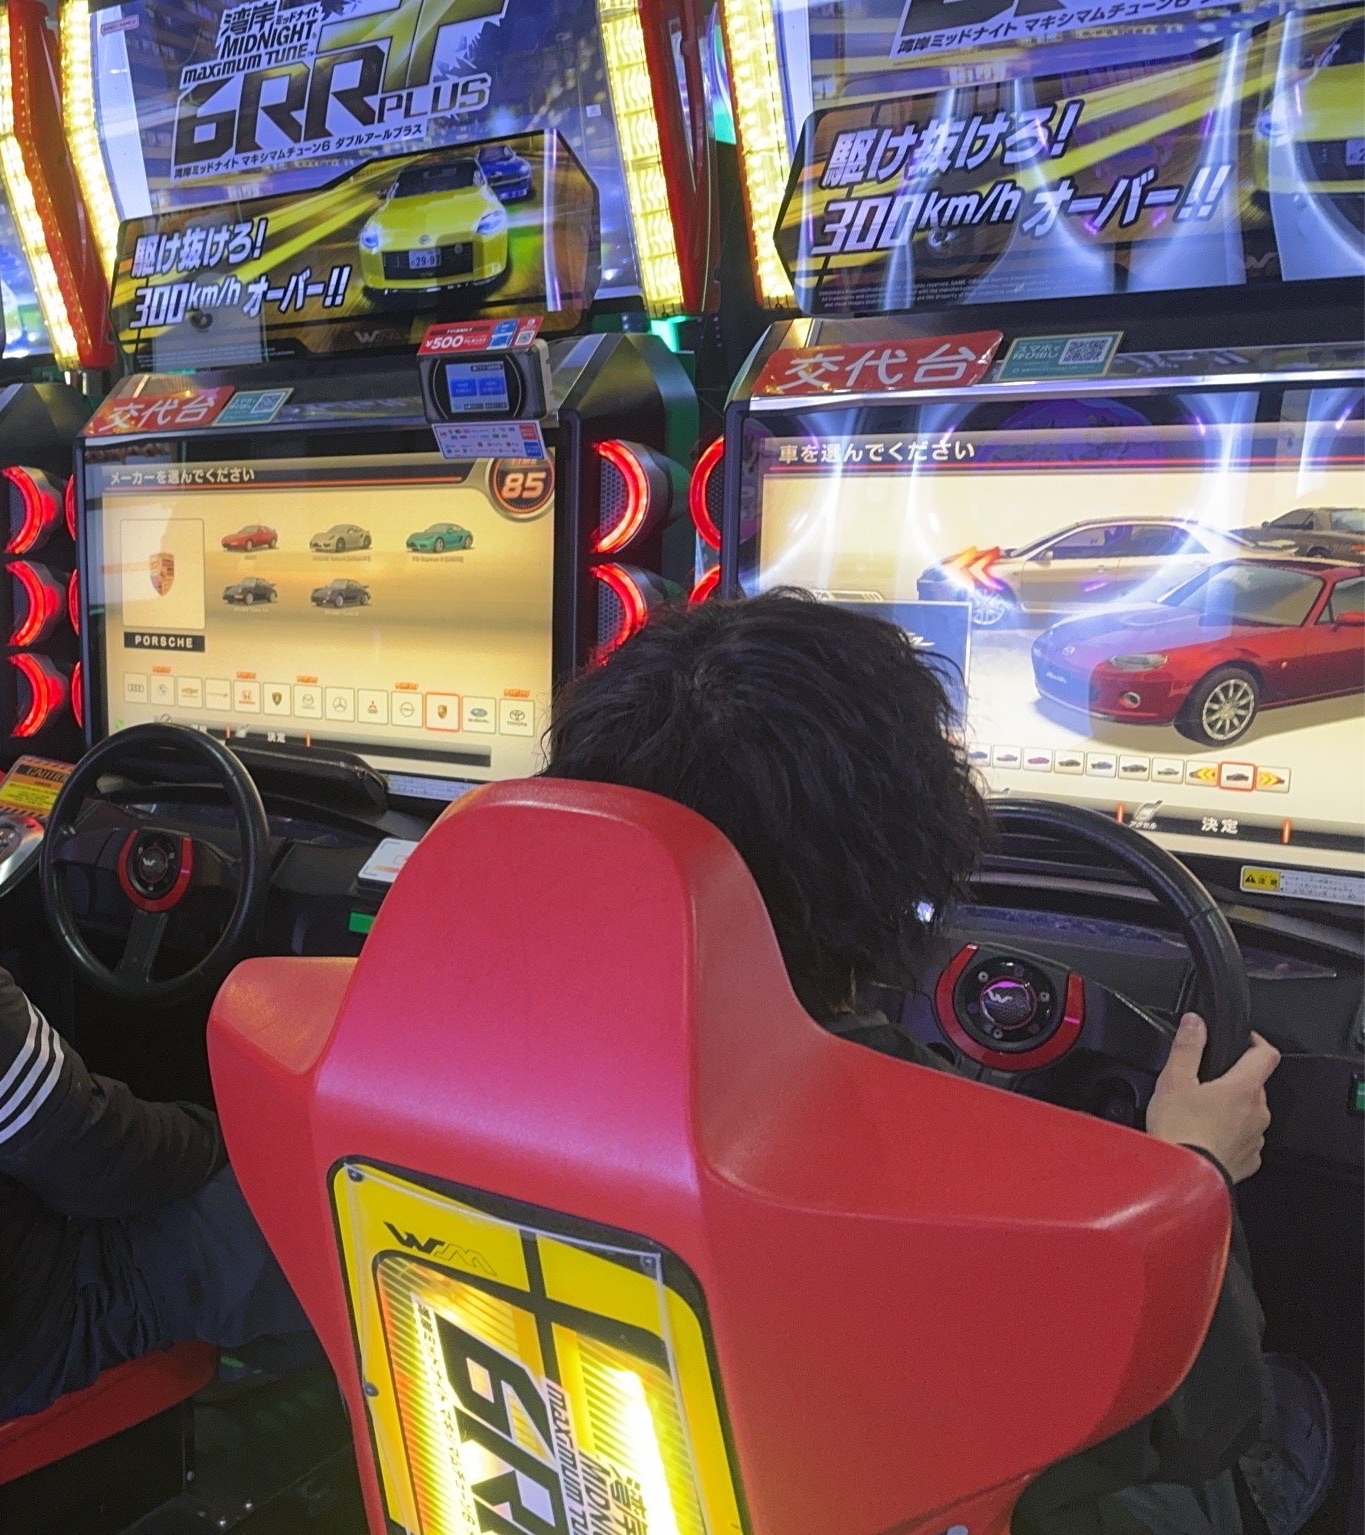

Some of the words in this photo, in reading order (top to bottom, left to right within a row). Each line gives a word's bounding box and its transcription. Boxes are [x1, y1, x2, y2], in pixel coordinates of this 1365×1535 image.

[221, 19, 315, 59] MIDNIGHT
[896, 23, 1018, 54] 湾岸ミッドナイト
[377, 76, 490, 124] PLUS
[777, 342, 977, 391] 交代台
[99, 394, 216, 432] 交代台
[778, 441, 975, 464] 車を選んでください
[110, 467, 255, 486] メーカーを選んでください
[502, 472, 546, 499] 85
[135, 634, 194, 650] PORSCHE
[1201, 816, 1239, 835] 決定
